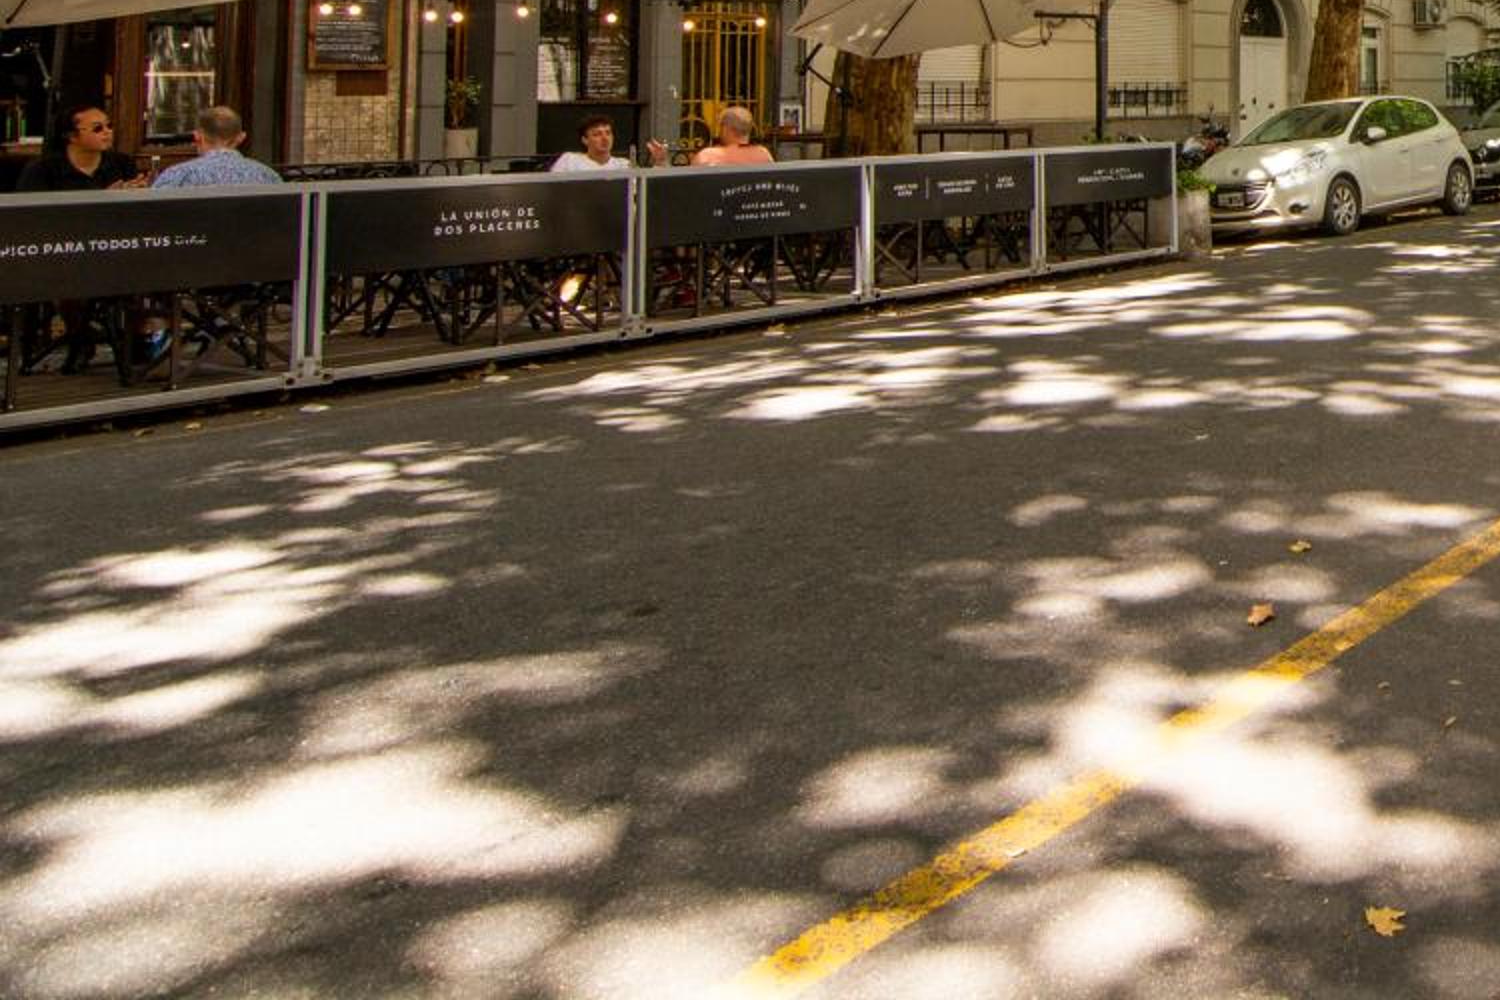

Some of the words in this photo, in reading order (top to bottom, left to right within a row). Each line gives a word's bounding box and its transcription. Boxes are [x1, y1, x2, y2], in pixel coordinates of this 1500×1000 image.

[440, 211, 457, 222] LA
[463, 206, 511, 220] UNIÓN
[517, 207, 536, 217] DE
[433, 224, 463, 236] DOS
[468, 219, 541, 233] PLACERES
[43, 240, 85, 255] PARA
[88, 237, 140, 251] TODOS
[143, 235, 171, 248] TUS
